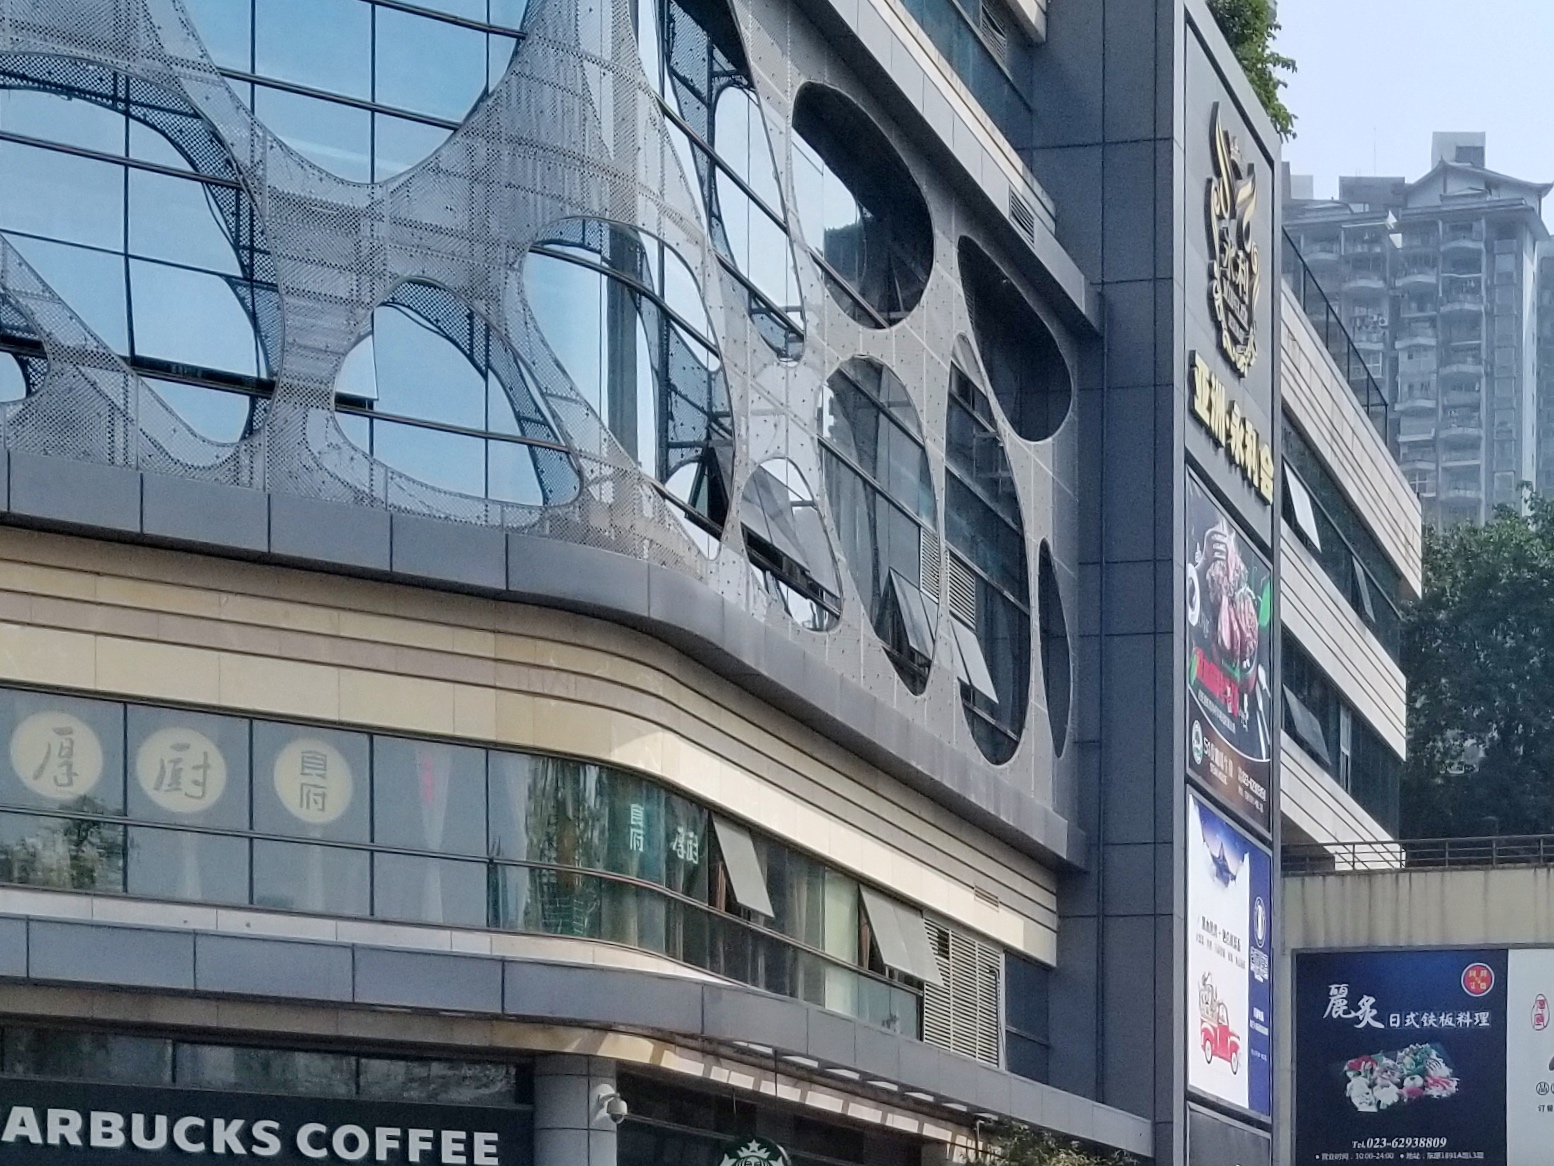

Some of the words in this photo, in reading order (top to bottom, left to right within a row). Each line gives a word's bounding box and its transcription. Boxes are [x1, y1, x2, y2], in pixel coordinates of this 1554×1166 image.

[1389, 1010, 1491, 1028] 日式铁板料理
[296, 1122, 500, 1166] COFFEE
